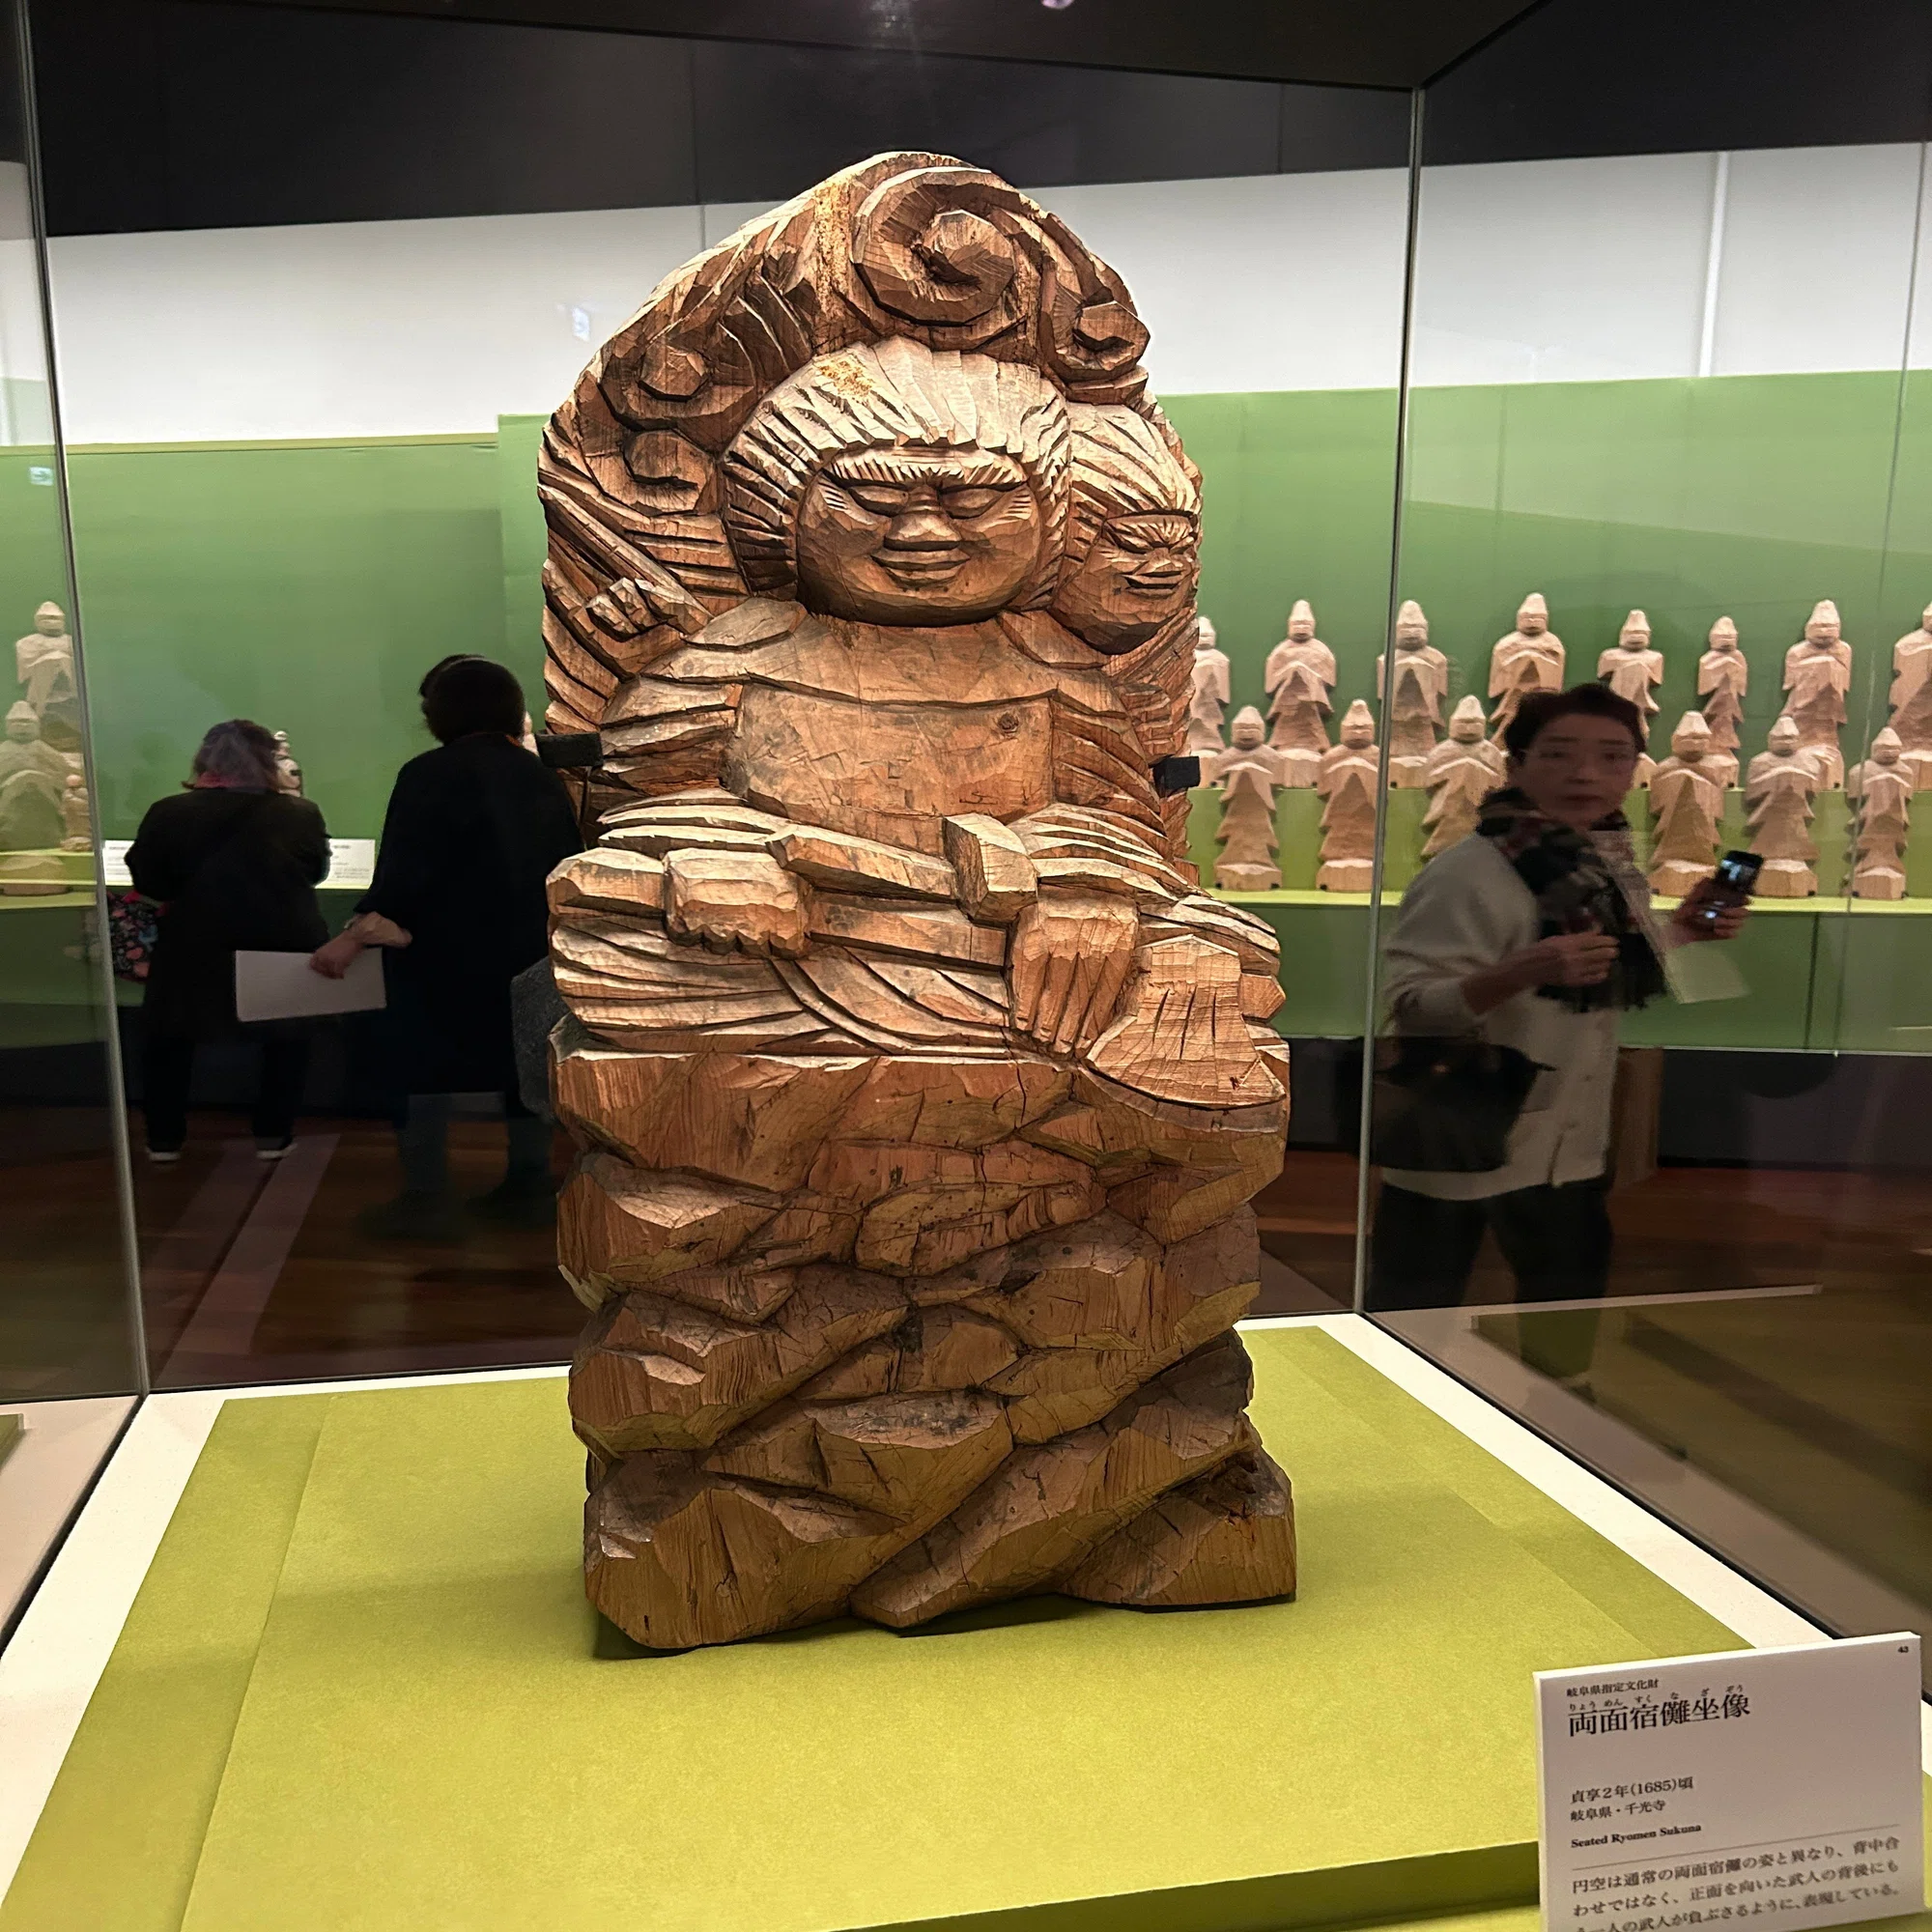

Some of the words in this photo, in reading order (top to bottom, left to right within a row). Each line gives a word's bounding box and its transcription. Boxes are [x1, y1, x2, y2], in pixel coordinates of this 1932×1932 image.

[1566, 1678, 1659, 1697] 岐阜県指定文化財
[1568, 1693, 1750, 1737] 両面宿儺坐像
[1570, 1799, 1665, 1822] 岐阜県・千光寺
[1571, 1835, 1608, 1848] Seated
[1611, 1830, 1657, 1844] Ryomen
[1660, 1824, 1702, 1836] Sukuna
